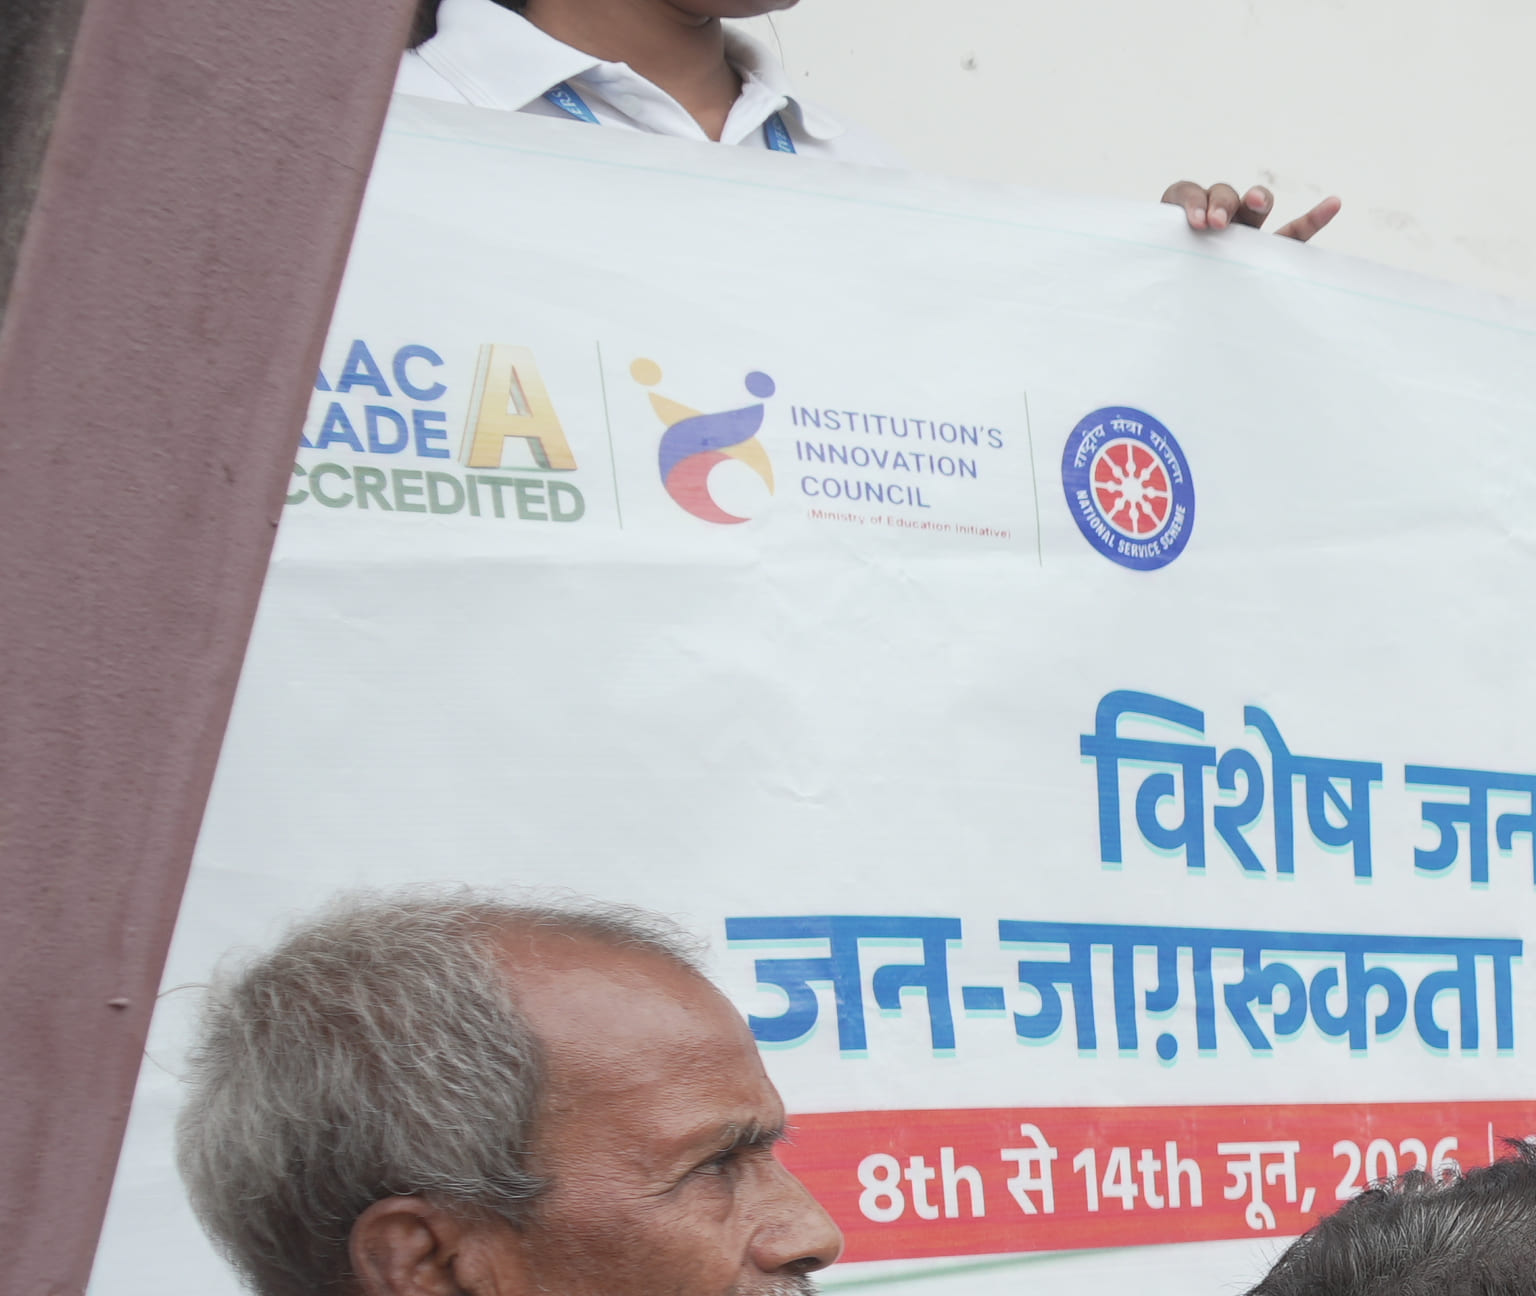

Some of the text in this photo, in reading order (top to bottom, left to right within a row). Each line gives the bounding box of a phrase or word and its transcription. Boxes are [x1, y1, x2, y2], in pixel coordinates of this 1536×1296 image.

[312, 339, 448, 401] AC
[298, 402, 450, 460] ADE
[458, 343, 578, 471] A
[791, 405, 1004, 449] INSTITUTION'S
[796, 440, 978, 480] INNOVATION
[800, 475, 932, 508] COUNCIL
[870, 515, 884, 526] of
[887, 516, 952, 533] Education
[1076, 489, 1187, 559] NATIONAL SERVICE SCHEME
[1080, 689, 1383, 880] विशेष
[856, 1146, 986, 1223] 8th
[1001, 1123, 1058, 1216] से
[1072, 1140, 1203, 1214] 14th
